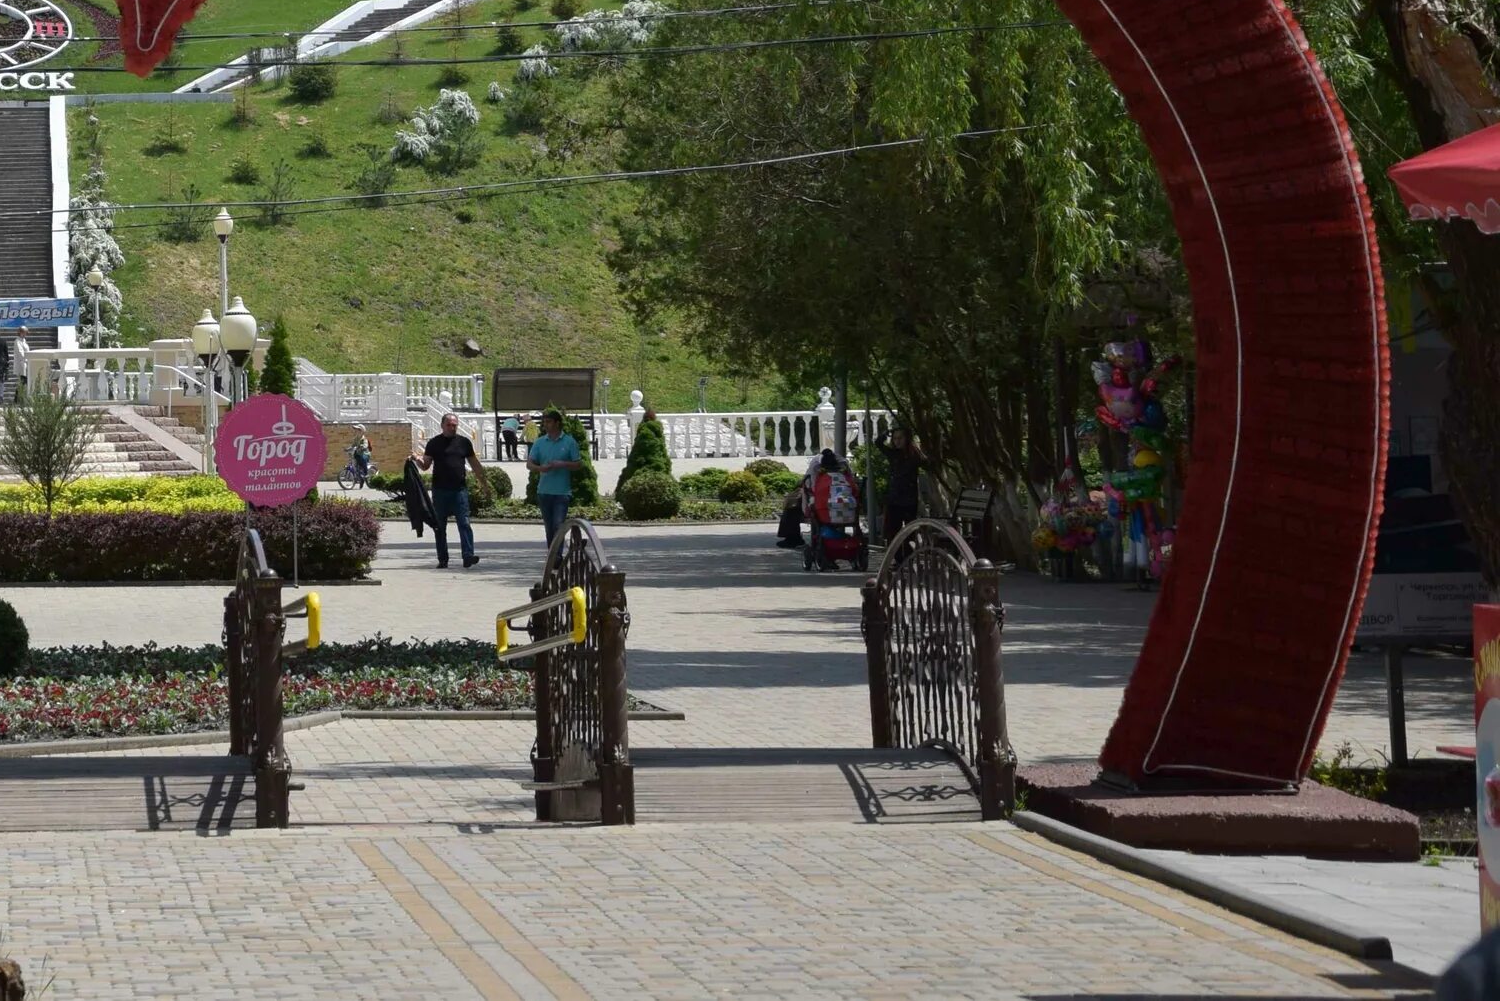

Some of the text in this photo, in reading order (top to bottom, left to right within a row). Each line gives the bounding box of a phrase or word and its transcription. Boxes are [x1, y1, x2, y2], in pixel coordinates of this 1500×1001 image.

[34, 19, 67, 37] III
[233, 434, 307, 467] Город
[248, 467, 296, 480] красоты
[245, 480, 302, 492] талантов
